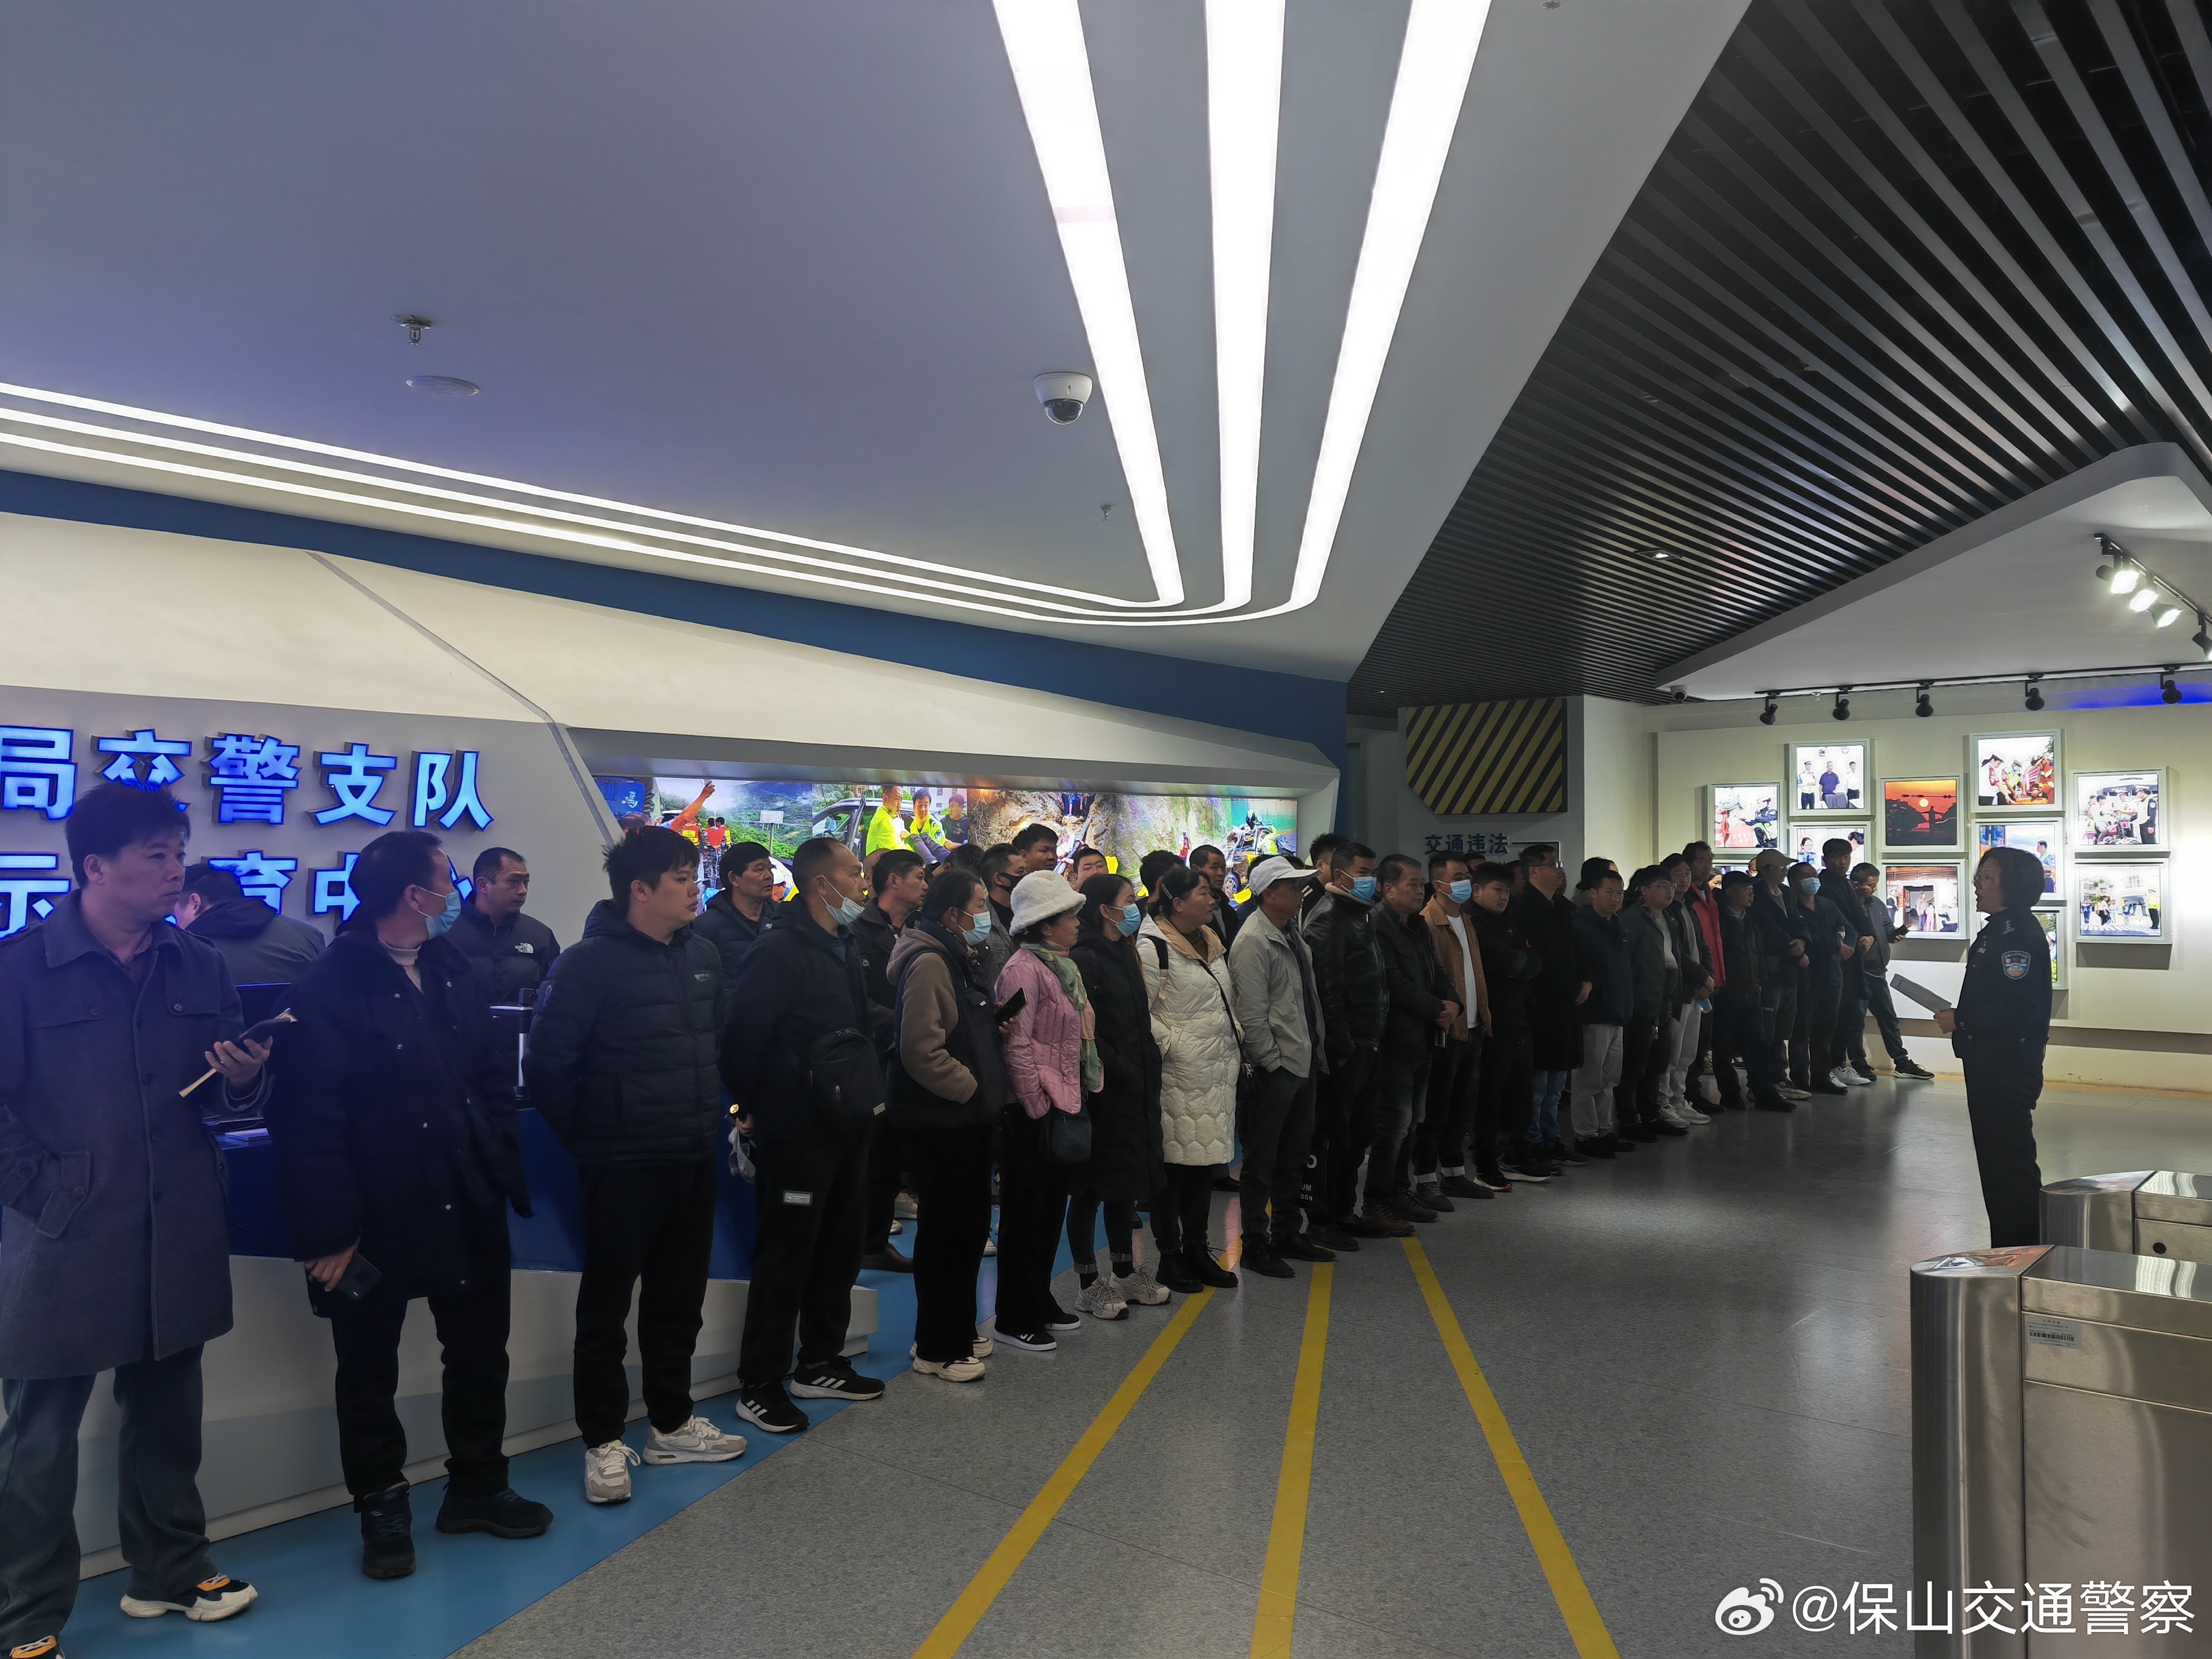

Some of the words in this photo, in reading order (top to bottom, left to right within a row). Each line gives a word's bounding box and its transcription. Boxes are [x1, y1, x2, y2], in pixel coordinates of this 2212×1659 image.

[0, 726, 494, 831] 局交警支队
[1425, 833, 1509, 855] 交通违法
